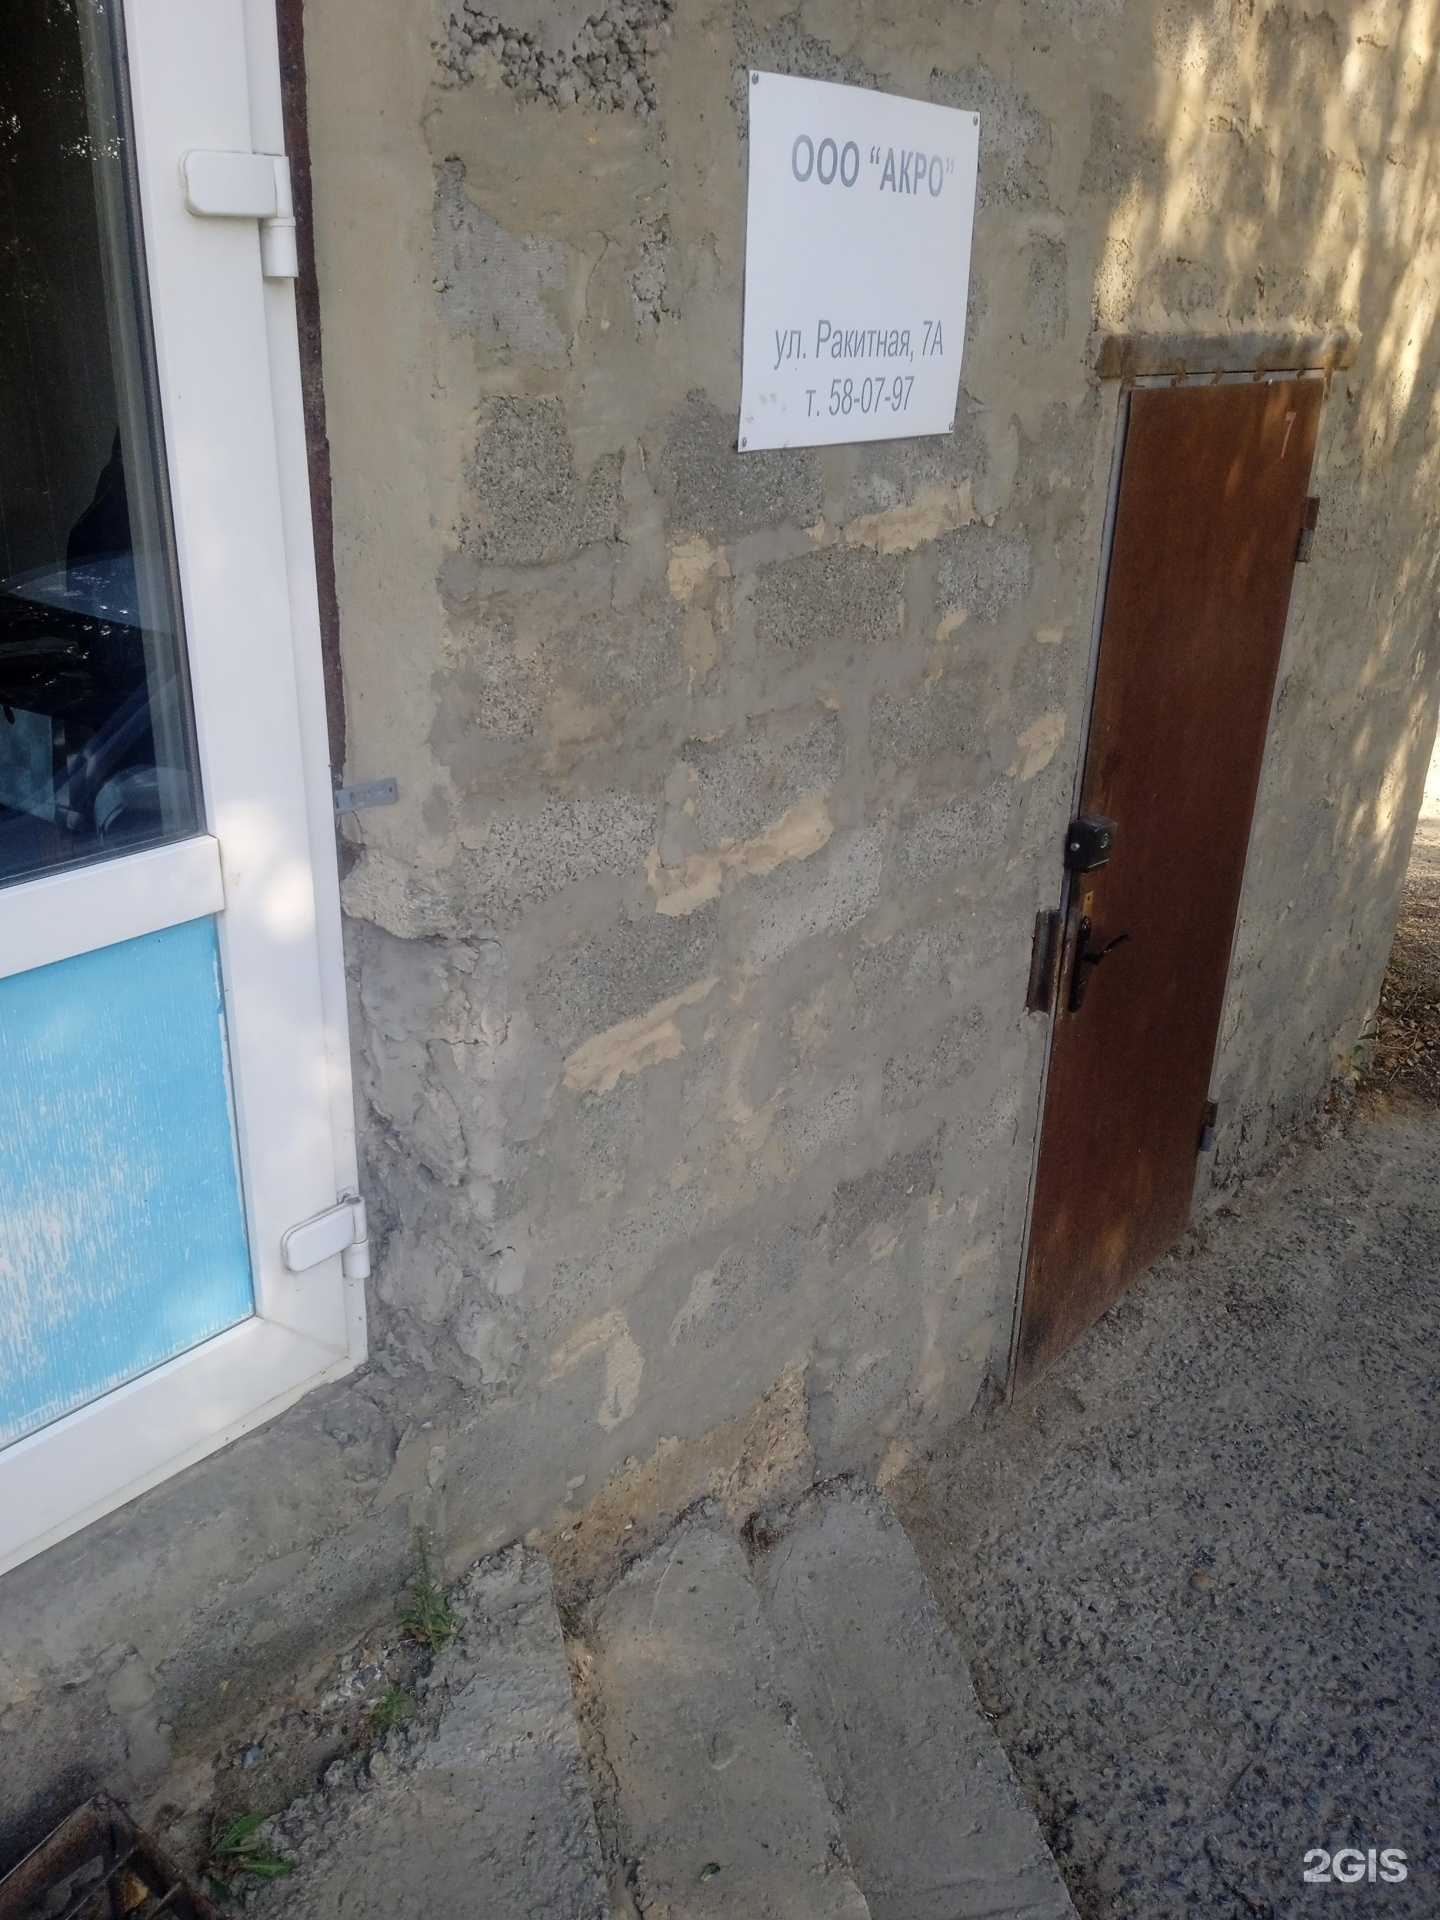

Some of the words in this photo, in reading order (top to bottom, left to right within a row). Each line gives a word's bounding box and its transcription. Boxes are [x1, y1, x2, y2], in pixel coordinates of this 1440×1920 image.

[791, 133, 860, 188] ООО
[773, 329, 807, 371] ул.
[815, 319, 915, 362] Ракитная,
[921, 319, 944, 357] 7А
[806, 389, 820, 417] т.
[828, 375, 915, 416] 58-07-97
